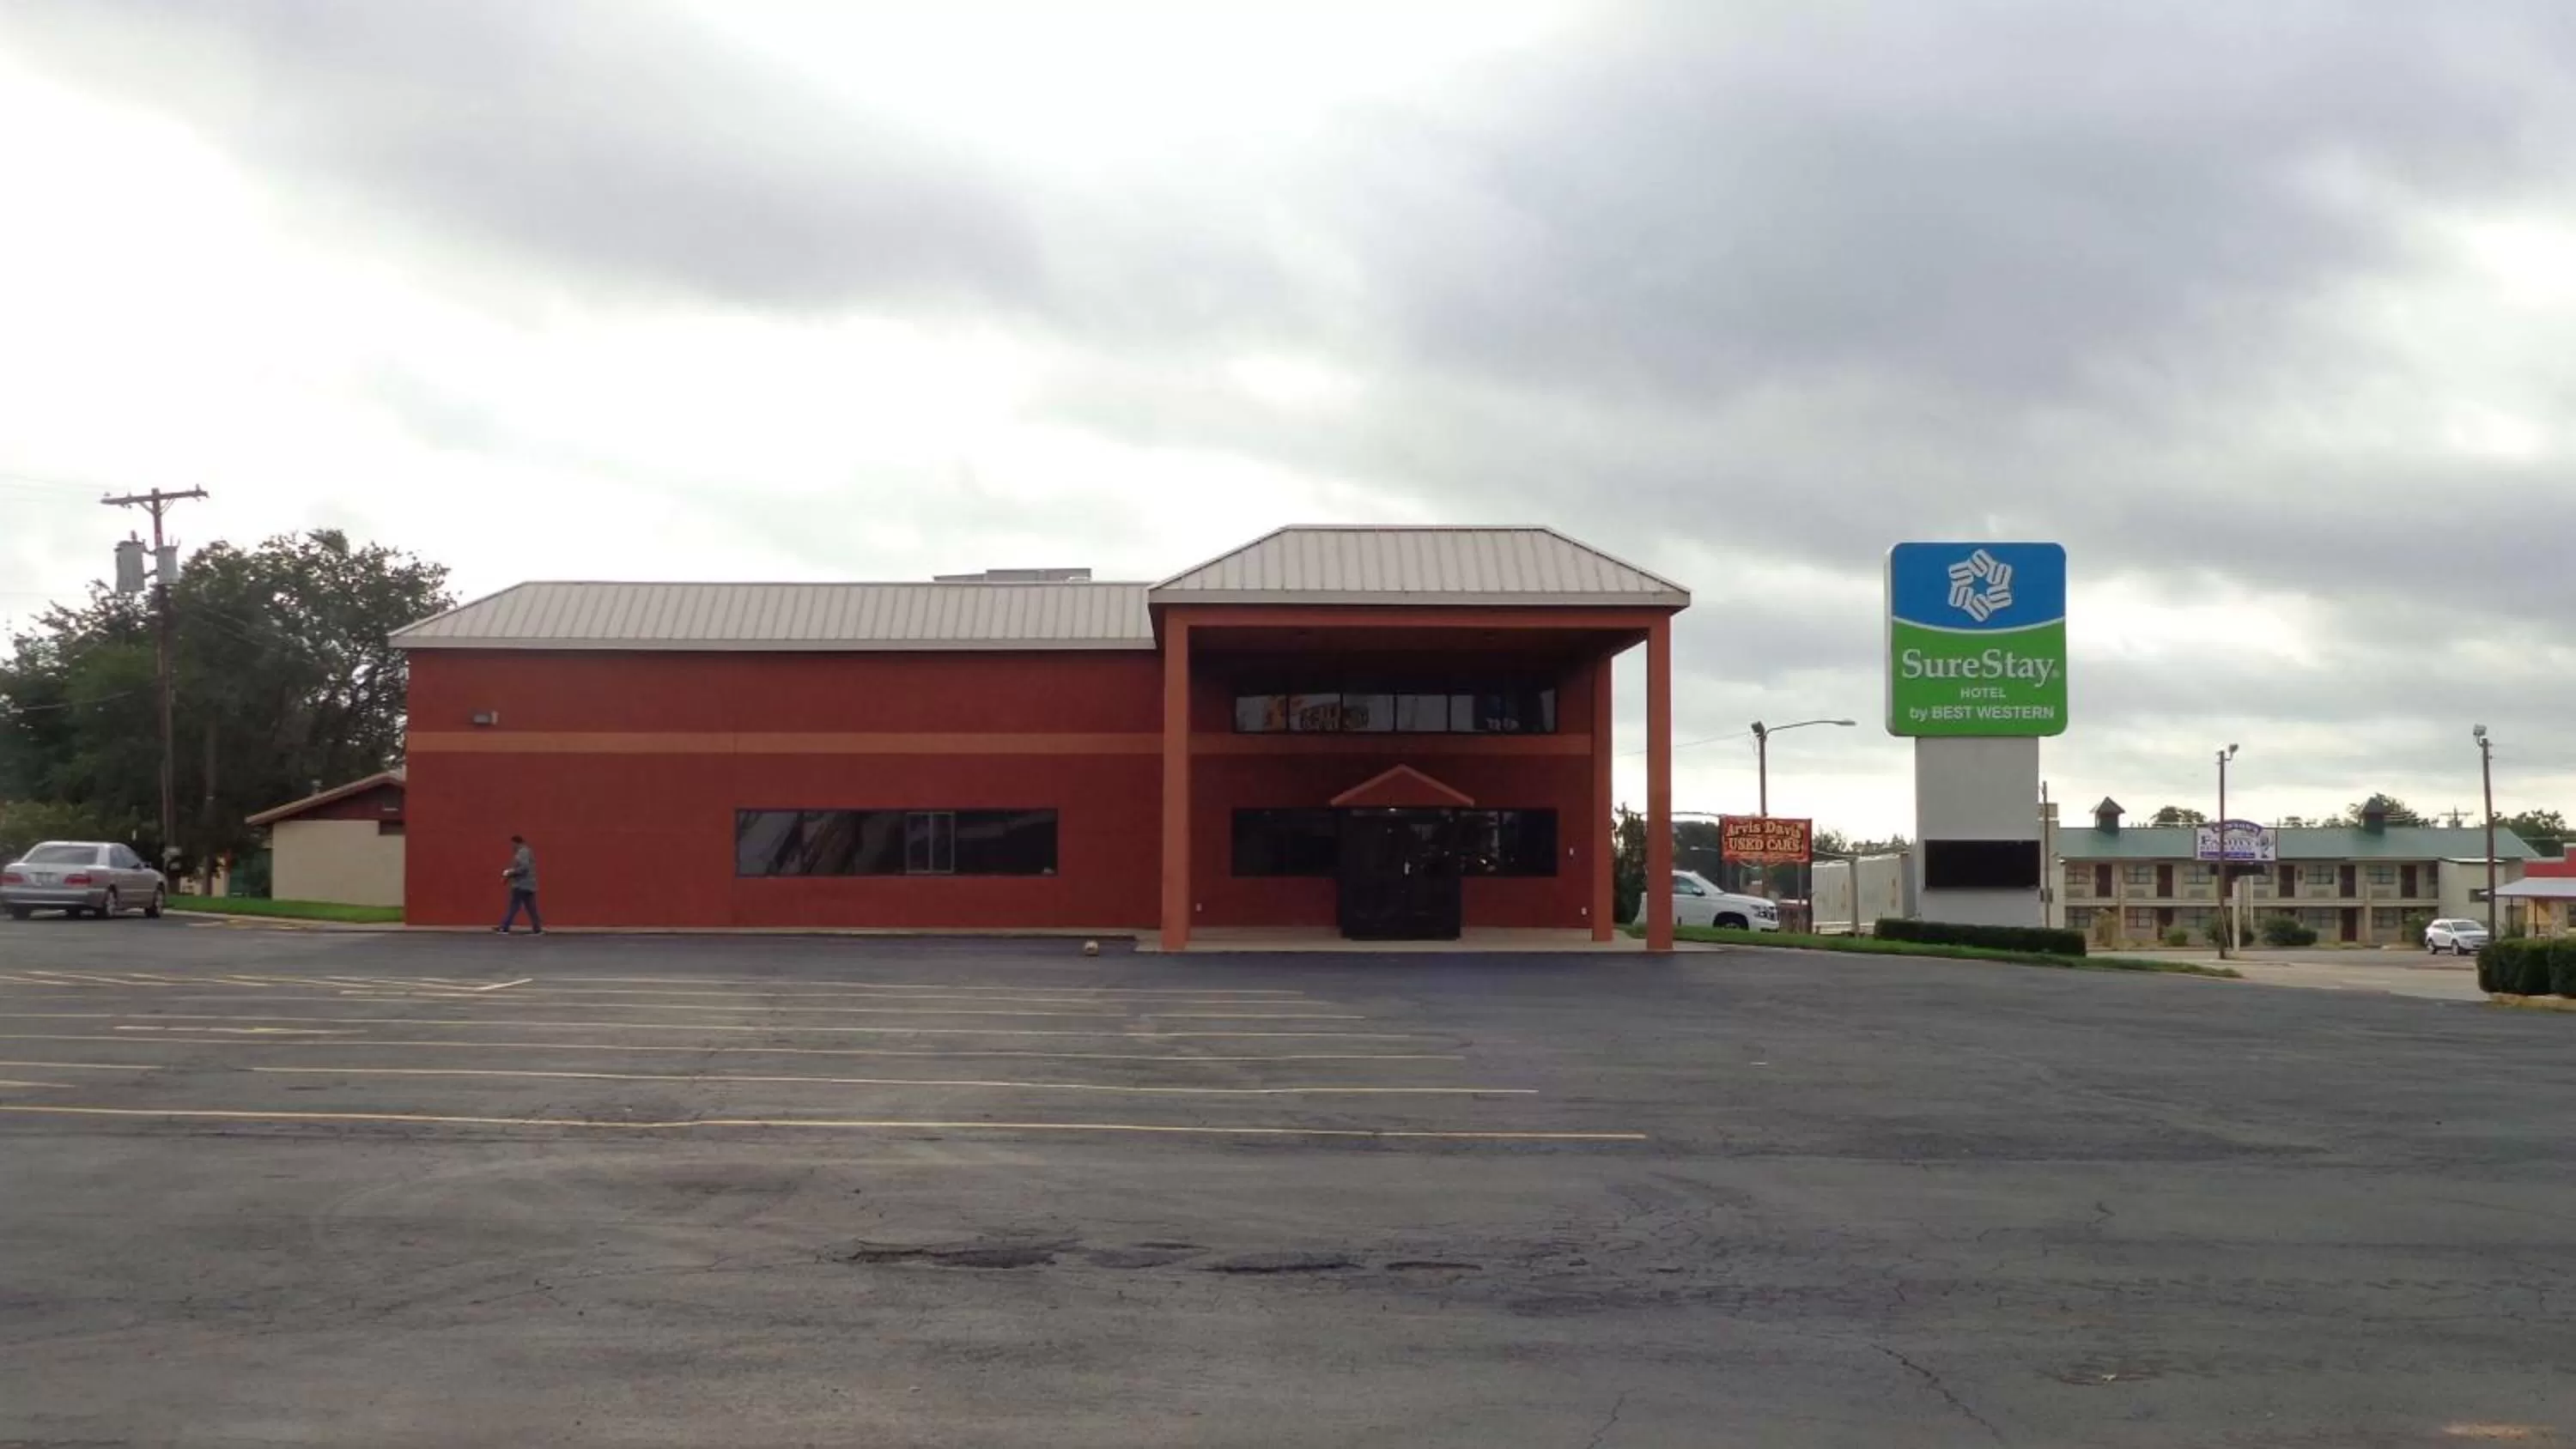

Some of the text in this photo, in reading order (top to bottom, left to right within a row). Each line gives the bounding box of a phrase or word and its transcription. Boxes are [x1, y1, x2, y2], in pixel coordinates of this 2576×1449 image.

[1901, 648, 2057, 688] SureStay
[1960, 688, 2007, 698] HOTEL
[1909, 706, 2055, 722] by BEST WESTERN
[1728, 838, 1801, 853] USED CARS
